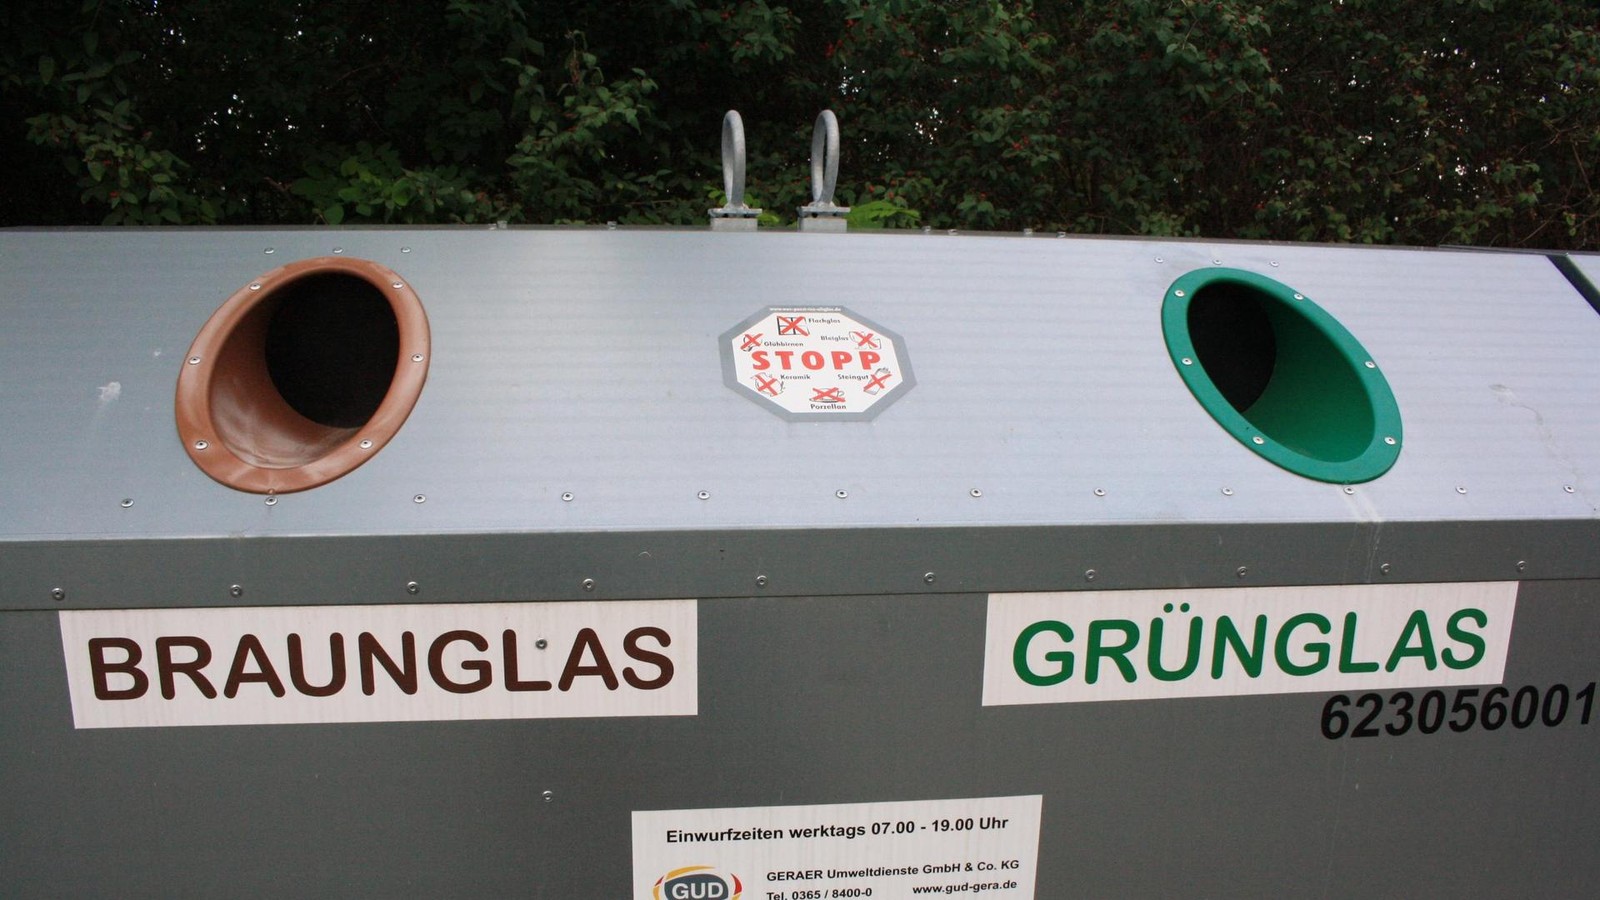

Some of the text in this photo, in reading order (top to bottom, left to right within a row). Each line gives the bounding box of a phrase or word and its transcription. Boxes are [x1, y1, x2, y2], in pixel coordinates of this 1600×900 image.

[808, 317, 841, 325] Flachglas
[751, 350, 881, 371] STOPP
[837, 373, 869, 381] Steingut
[810, 402, 847, 410] Porzellan
[1012, 602, 1488, 687] GRÜNGLAS
[88, 626, 675, 701] BRAUNGLAS
[1320, 681, 1597, 740] 623056001
[666, 828, 784, 843] Einwurfzeiten
[789, 824, 866, 840] werktags
[871, 820, 915, 835] 07.00
[931, 818, 974, 832] 19.00
[979, 816, 1009, 830] Uhr
[766, 859, 1020, 882] GERAER Umweltdienste GmbH & Co. KG
[671, 881, 724, 900] GUD
[766, 880, 1017, 900] Tel. 0365 / 8400-0 www.gud-gera.de
